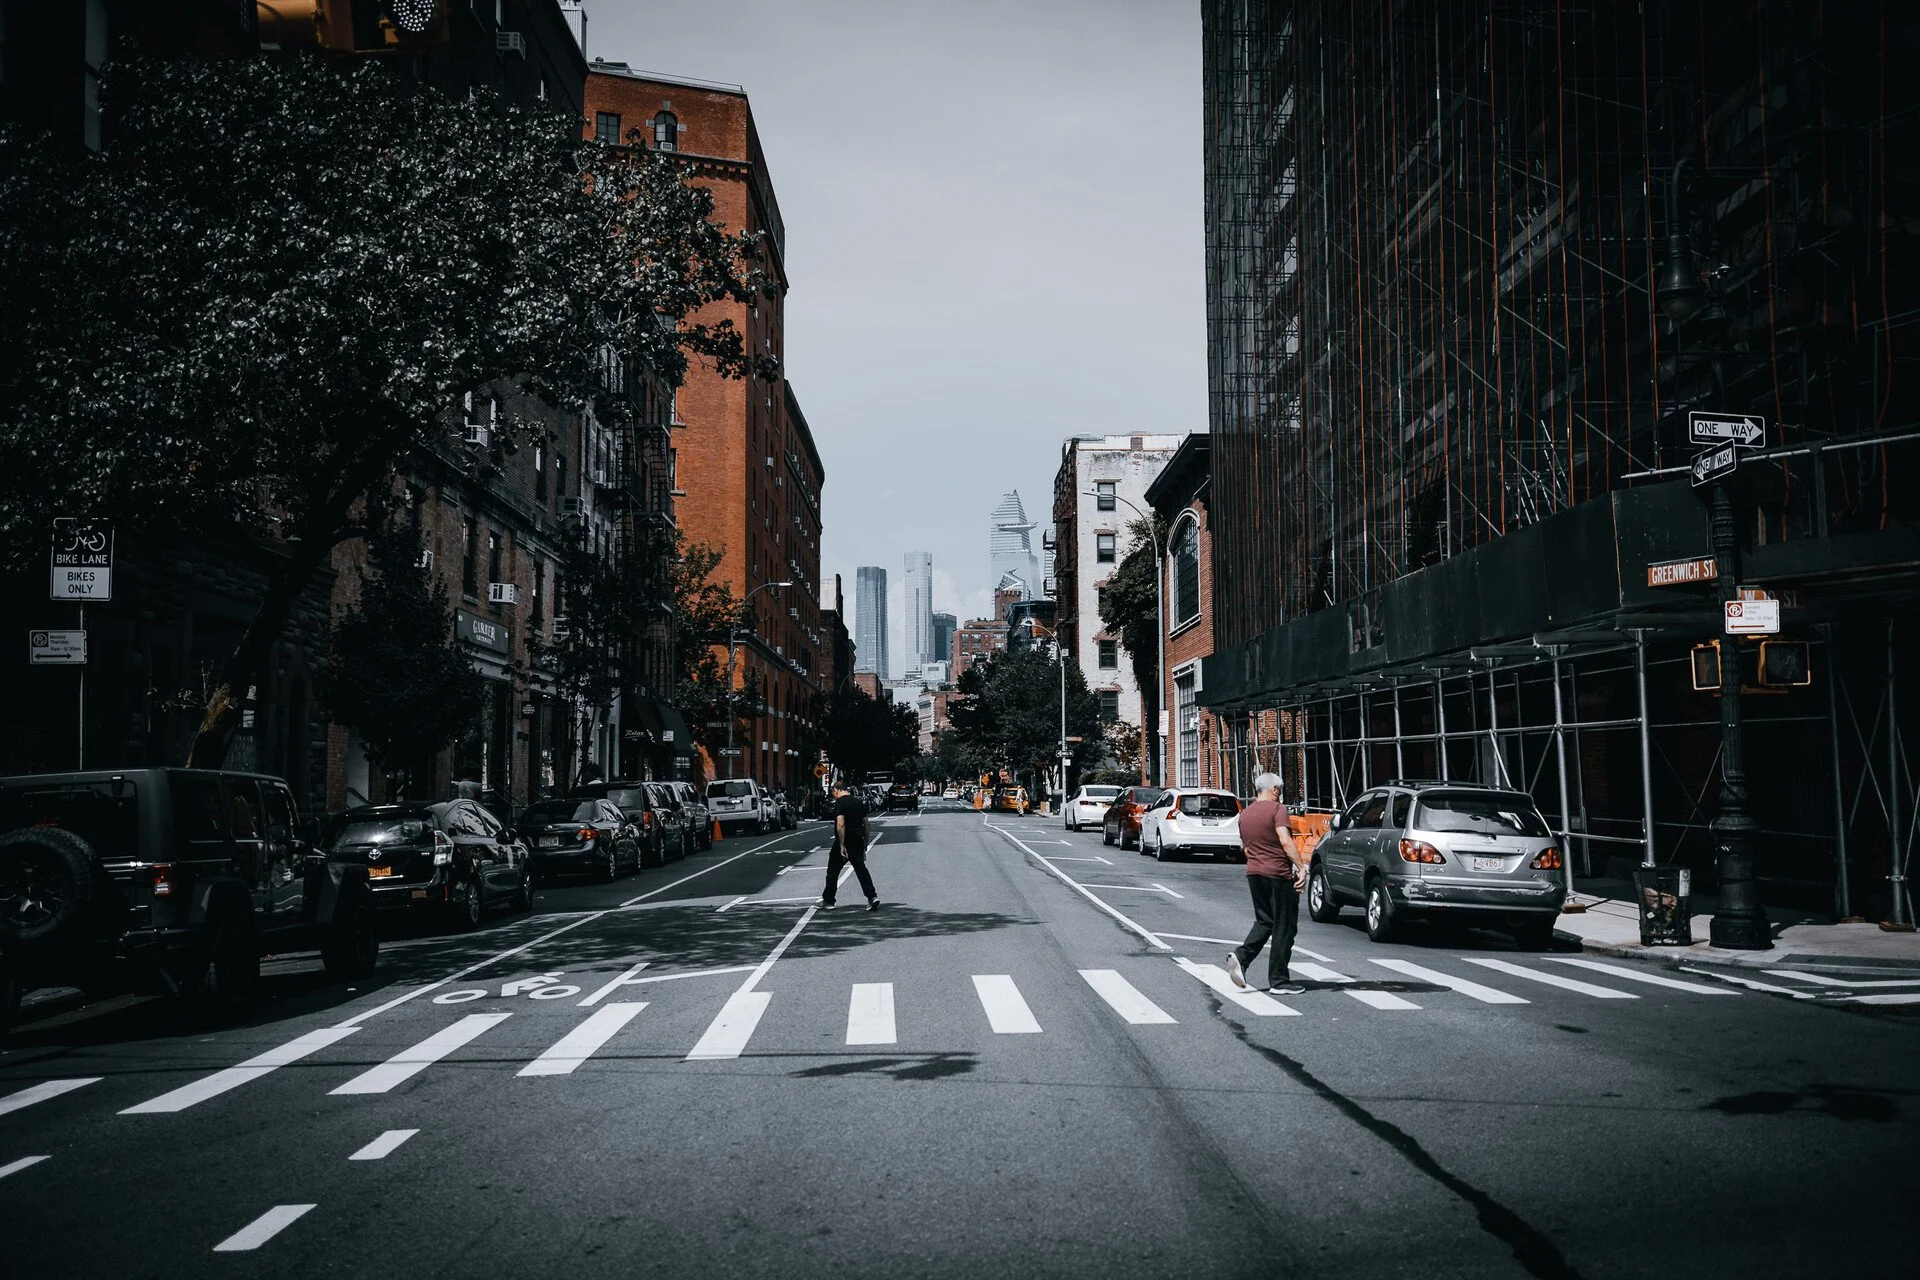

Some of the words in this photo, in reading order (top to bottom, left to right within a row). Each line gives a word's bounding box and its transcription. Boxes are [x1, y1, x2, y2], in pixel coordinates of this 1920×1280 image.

[1697, 422, 1718, 435] ONE
[1730, 424, 1754, 437] WAY
[1696, 459, 1710, 475] ONE
[1716, 449, 1731, 466] WAY
[56, 554, 78, 564] BIKE
[82, 554, 108, 564] LANE
[67, 572, 95, 581] BIKES
[1652, 561, 1700, 584] GREENWICH
[1703, 560, 1714, 577] ST
[68, 584, 93, 593] ONLY
[1744, 590, 1756, 601] W
[1782, 590, 1799, 609] ST
[473, 620, 496, 641] GARBER
